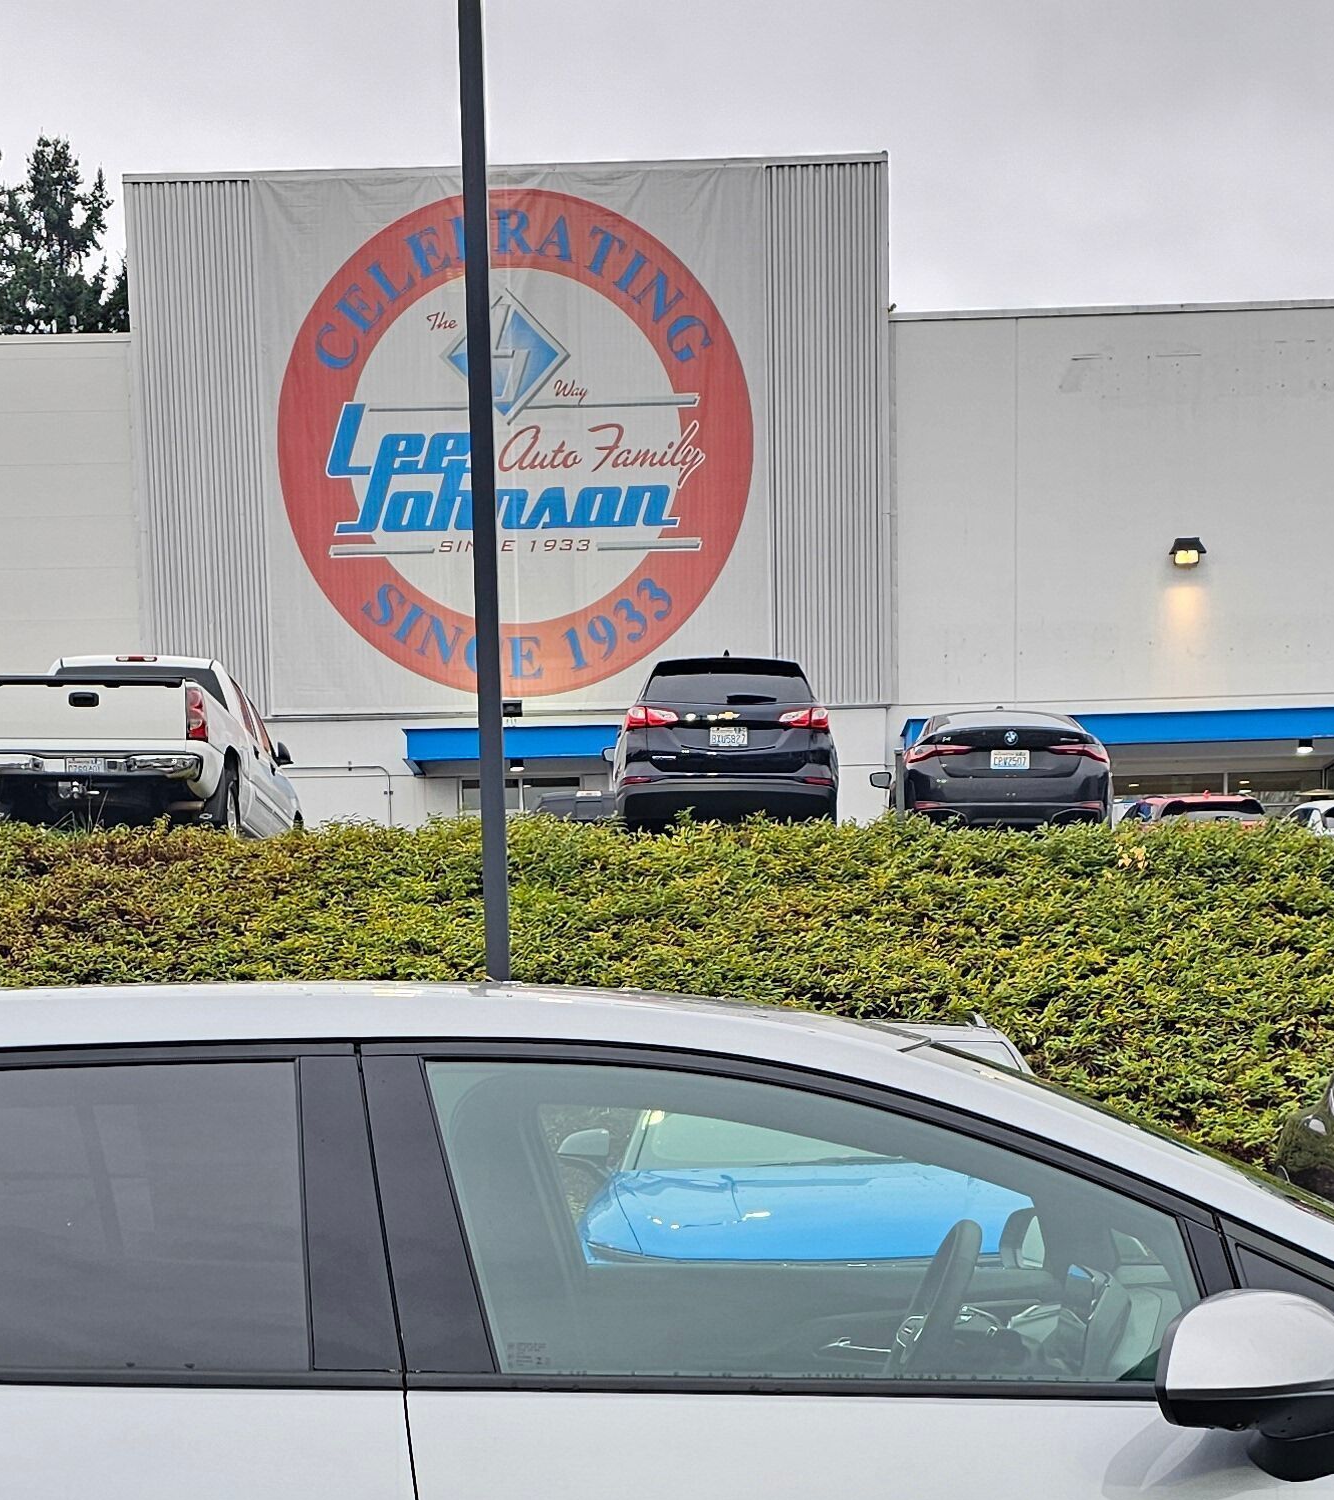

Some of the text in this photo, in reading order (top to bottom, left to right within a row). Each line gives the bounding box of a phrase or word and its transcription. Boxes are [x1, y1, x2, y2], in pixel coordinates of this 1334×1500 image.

[426, 311, 458, 331] The
[554, 379, 588, 399] Way
[498, 425, 582, 472] Auto
[588, 421, 703, 487] Family
[439, 538, 590, 553] SINE 1933
[562, 578, 672, 670] 1933
